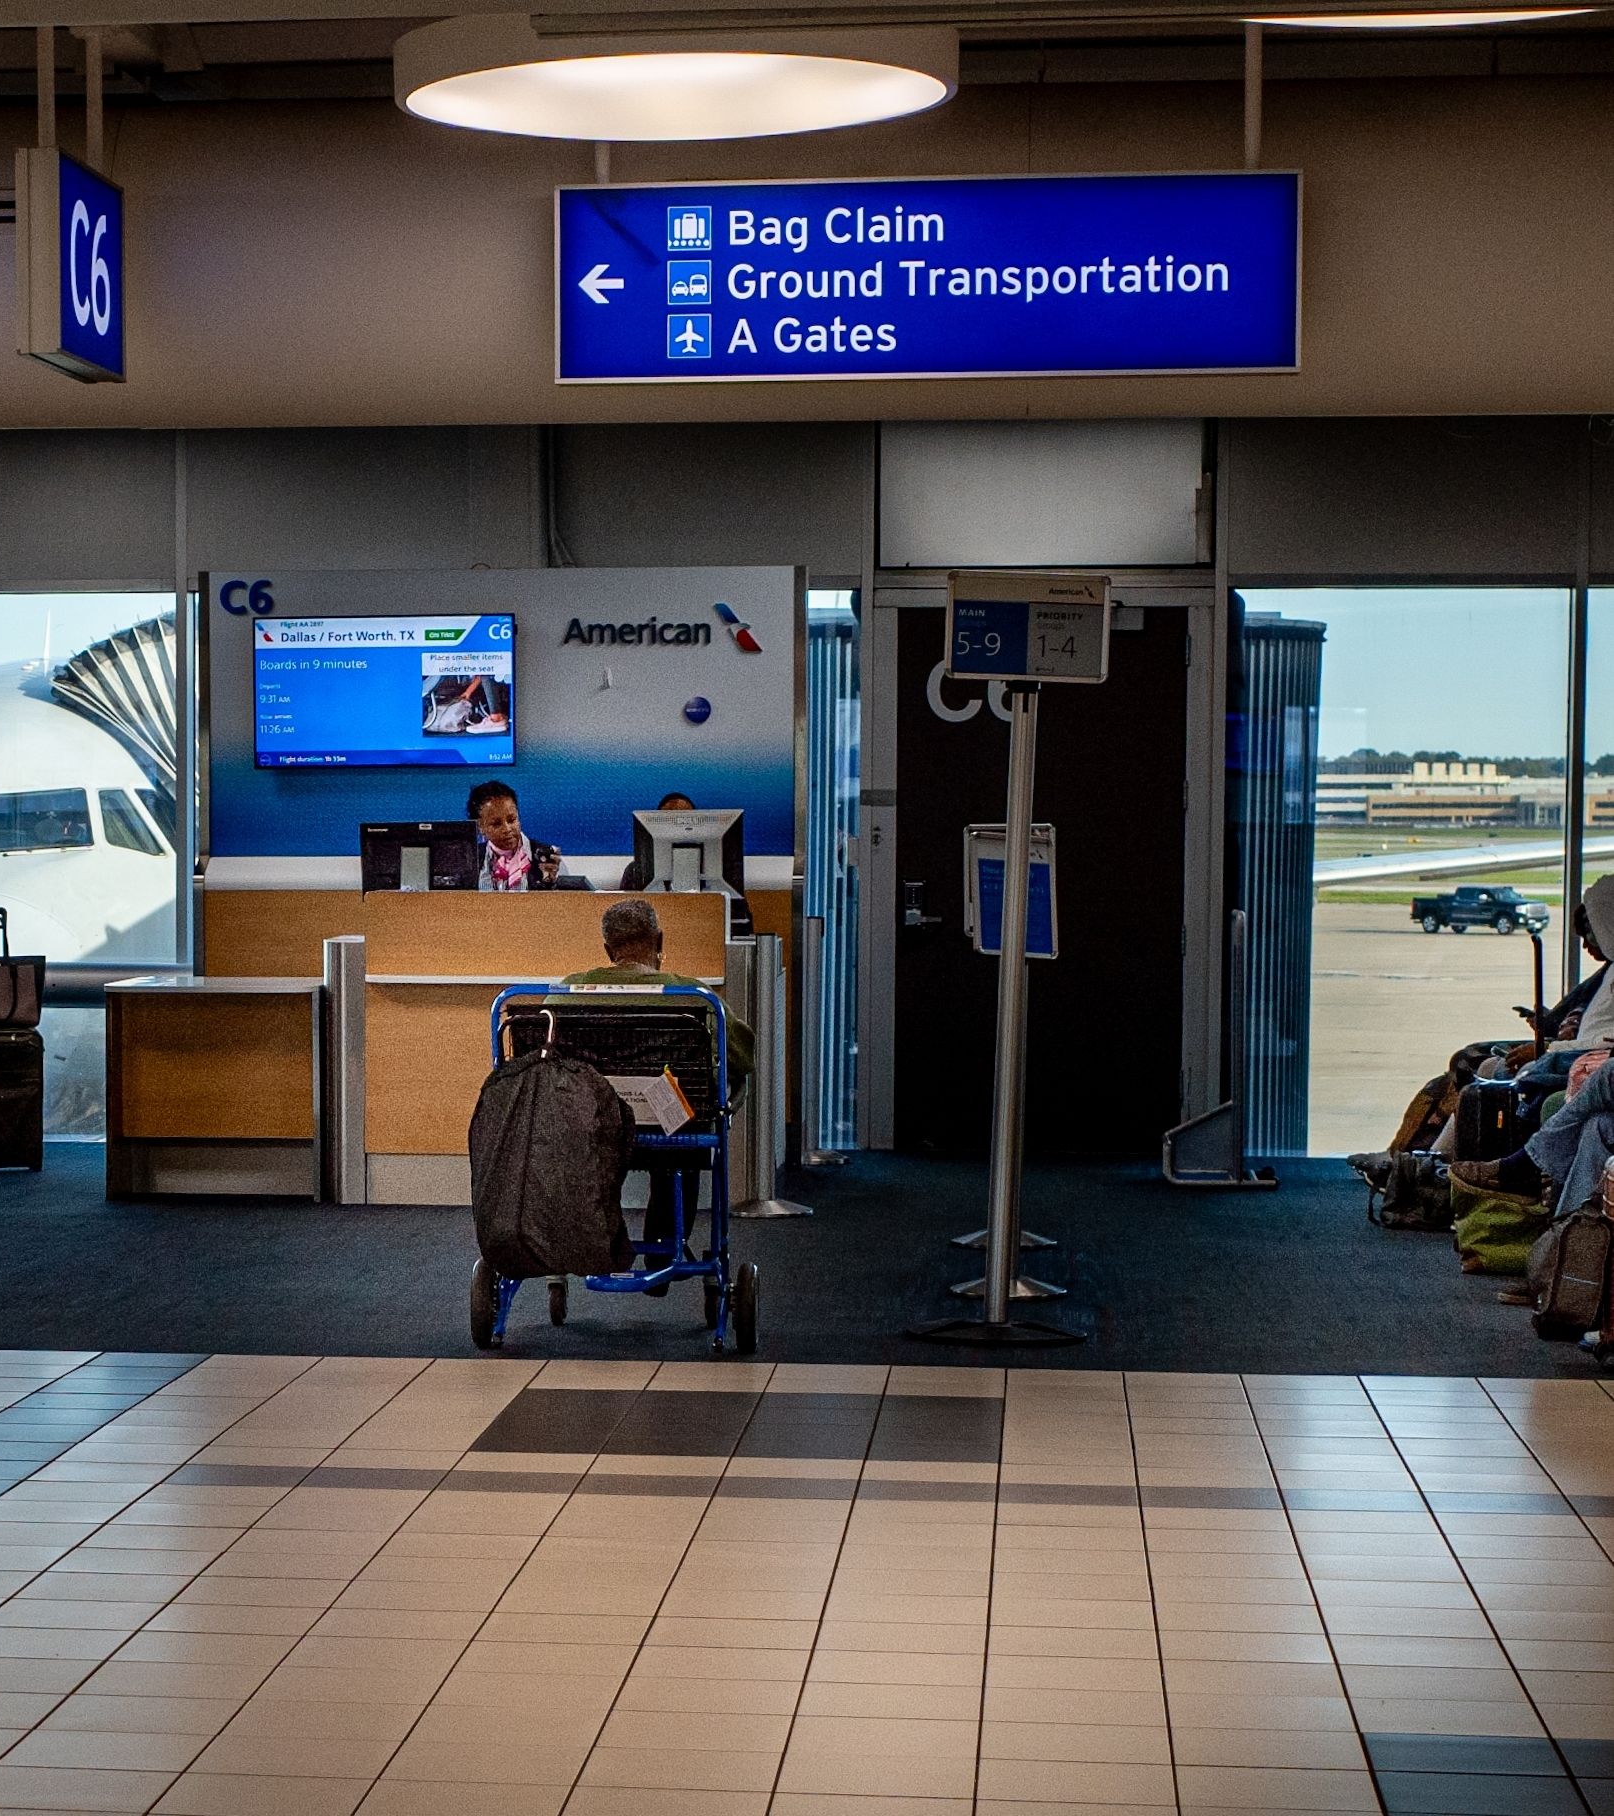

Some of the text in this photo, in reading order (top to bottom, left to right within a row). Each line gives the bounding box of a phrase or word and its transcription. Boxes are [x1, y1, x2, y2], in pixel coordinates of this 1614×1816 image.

[729, 205, 944, 253] Bag Claim
[70, 199, 110, 336] C6
[727, 255, 1229, 303] Ground Transportation
[727, 315, 897, 353] A Gates
[220, 580, 274, 615] C6
[1048, 587, 1084, 596] American
[958, 608, 986, 617] MAIN
[1036, 611, 1084, 621] PRIORITY
[281, 632, 316, 642] Dallas
[328, 631, 353, 641] Fort
[399, 630, 415, 640] TX
[488, 623, 512, 640] C6
[562, 616, 711, 646] American
[956, 631, 1001, 656] 5-9
[1037, 635, 1078, 659] 1-4
[260, 660, 368, 670] Boards in 9 minutes
[452, 653, 480, 661] smaller
